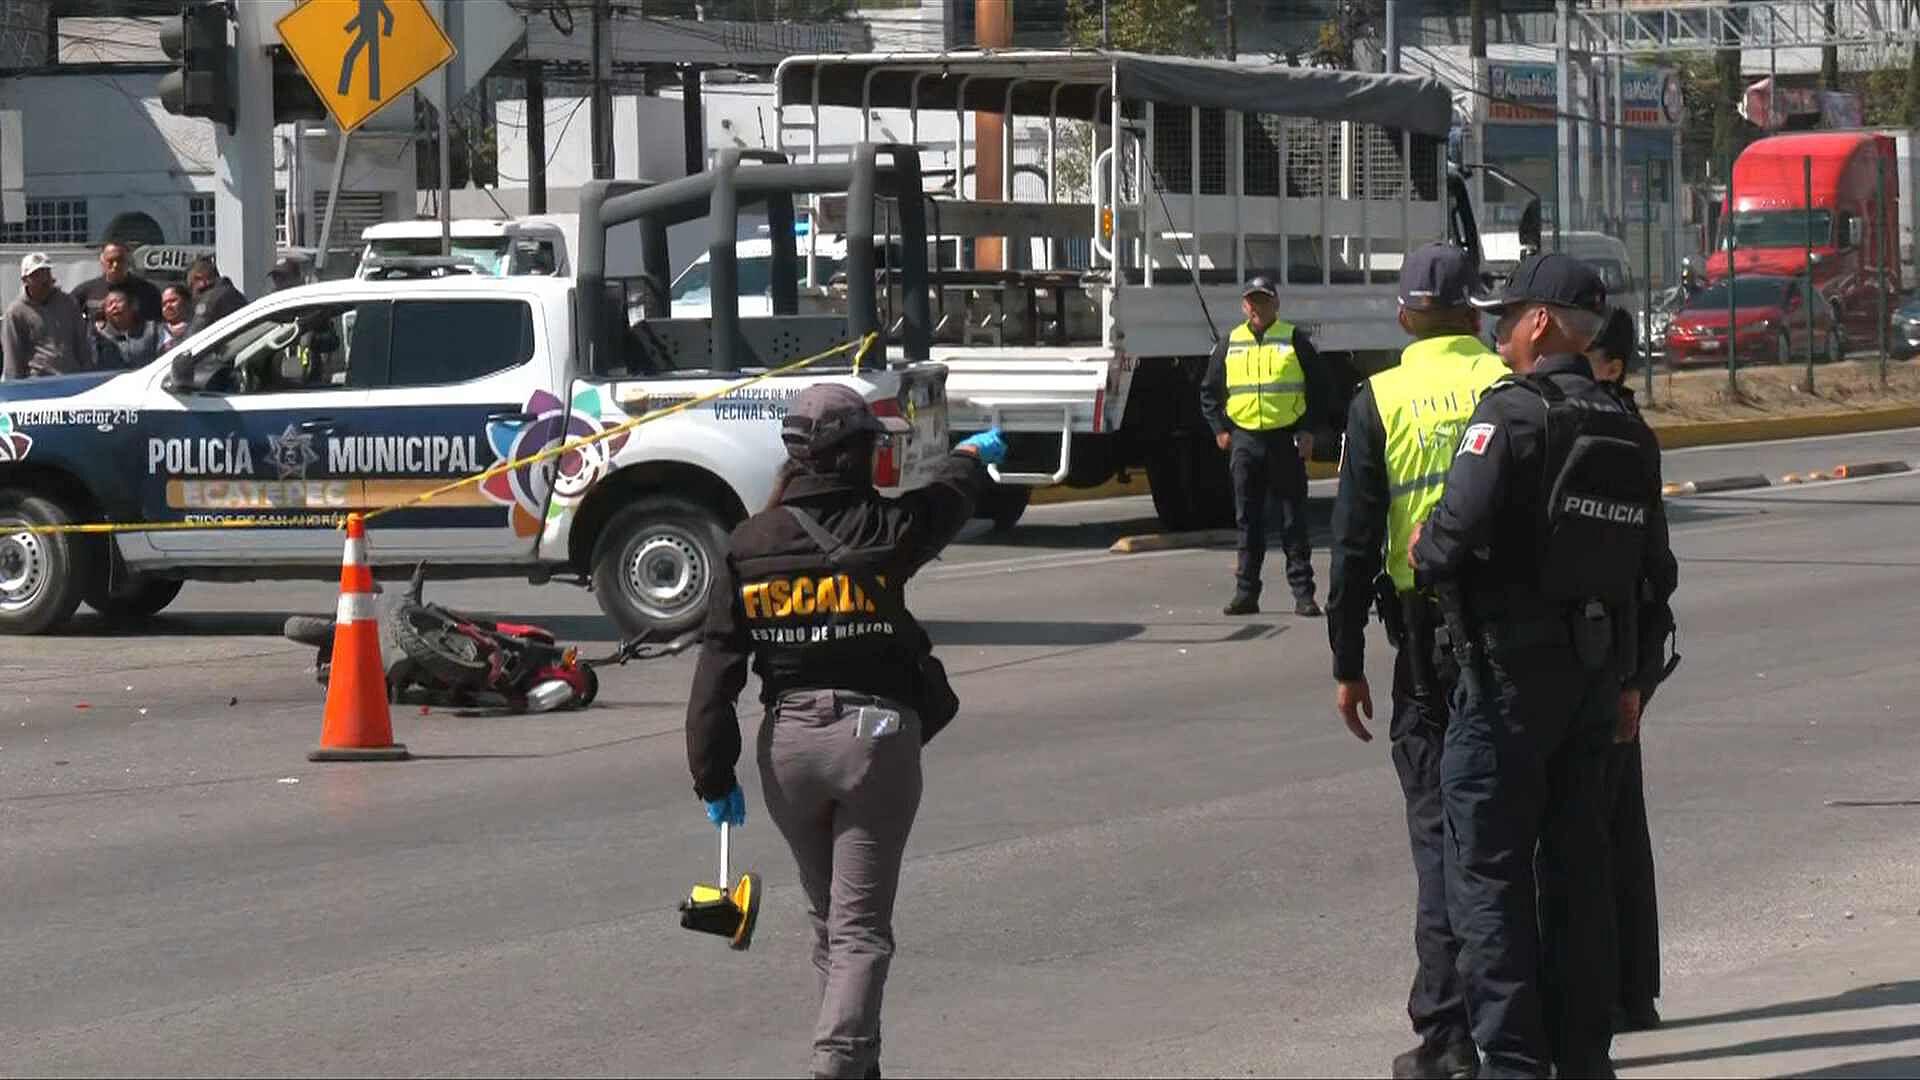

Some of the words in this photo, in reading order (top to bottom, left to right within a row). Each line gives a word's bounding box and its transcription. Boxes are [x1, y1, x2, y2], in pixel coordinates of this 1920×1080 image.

[16, 408, 67, 426] VECINAL
[68, 408, 111, 425] Sector
[714, 402, 766, 421] VECINAL
[149, 431, 254, 475] POLICÍA
[328, 437, 483, 474] MUNICIPAL
[184, 480, 346, 505] ECATEPEC
[1564, 496, 1645, 525] POLICIA
[751, 626, 806, 643] ESTADO
[811, 625, 829, 642] DE
